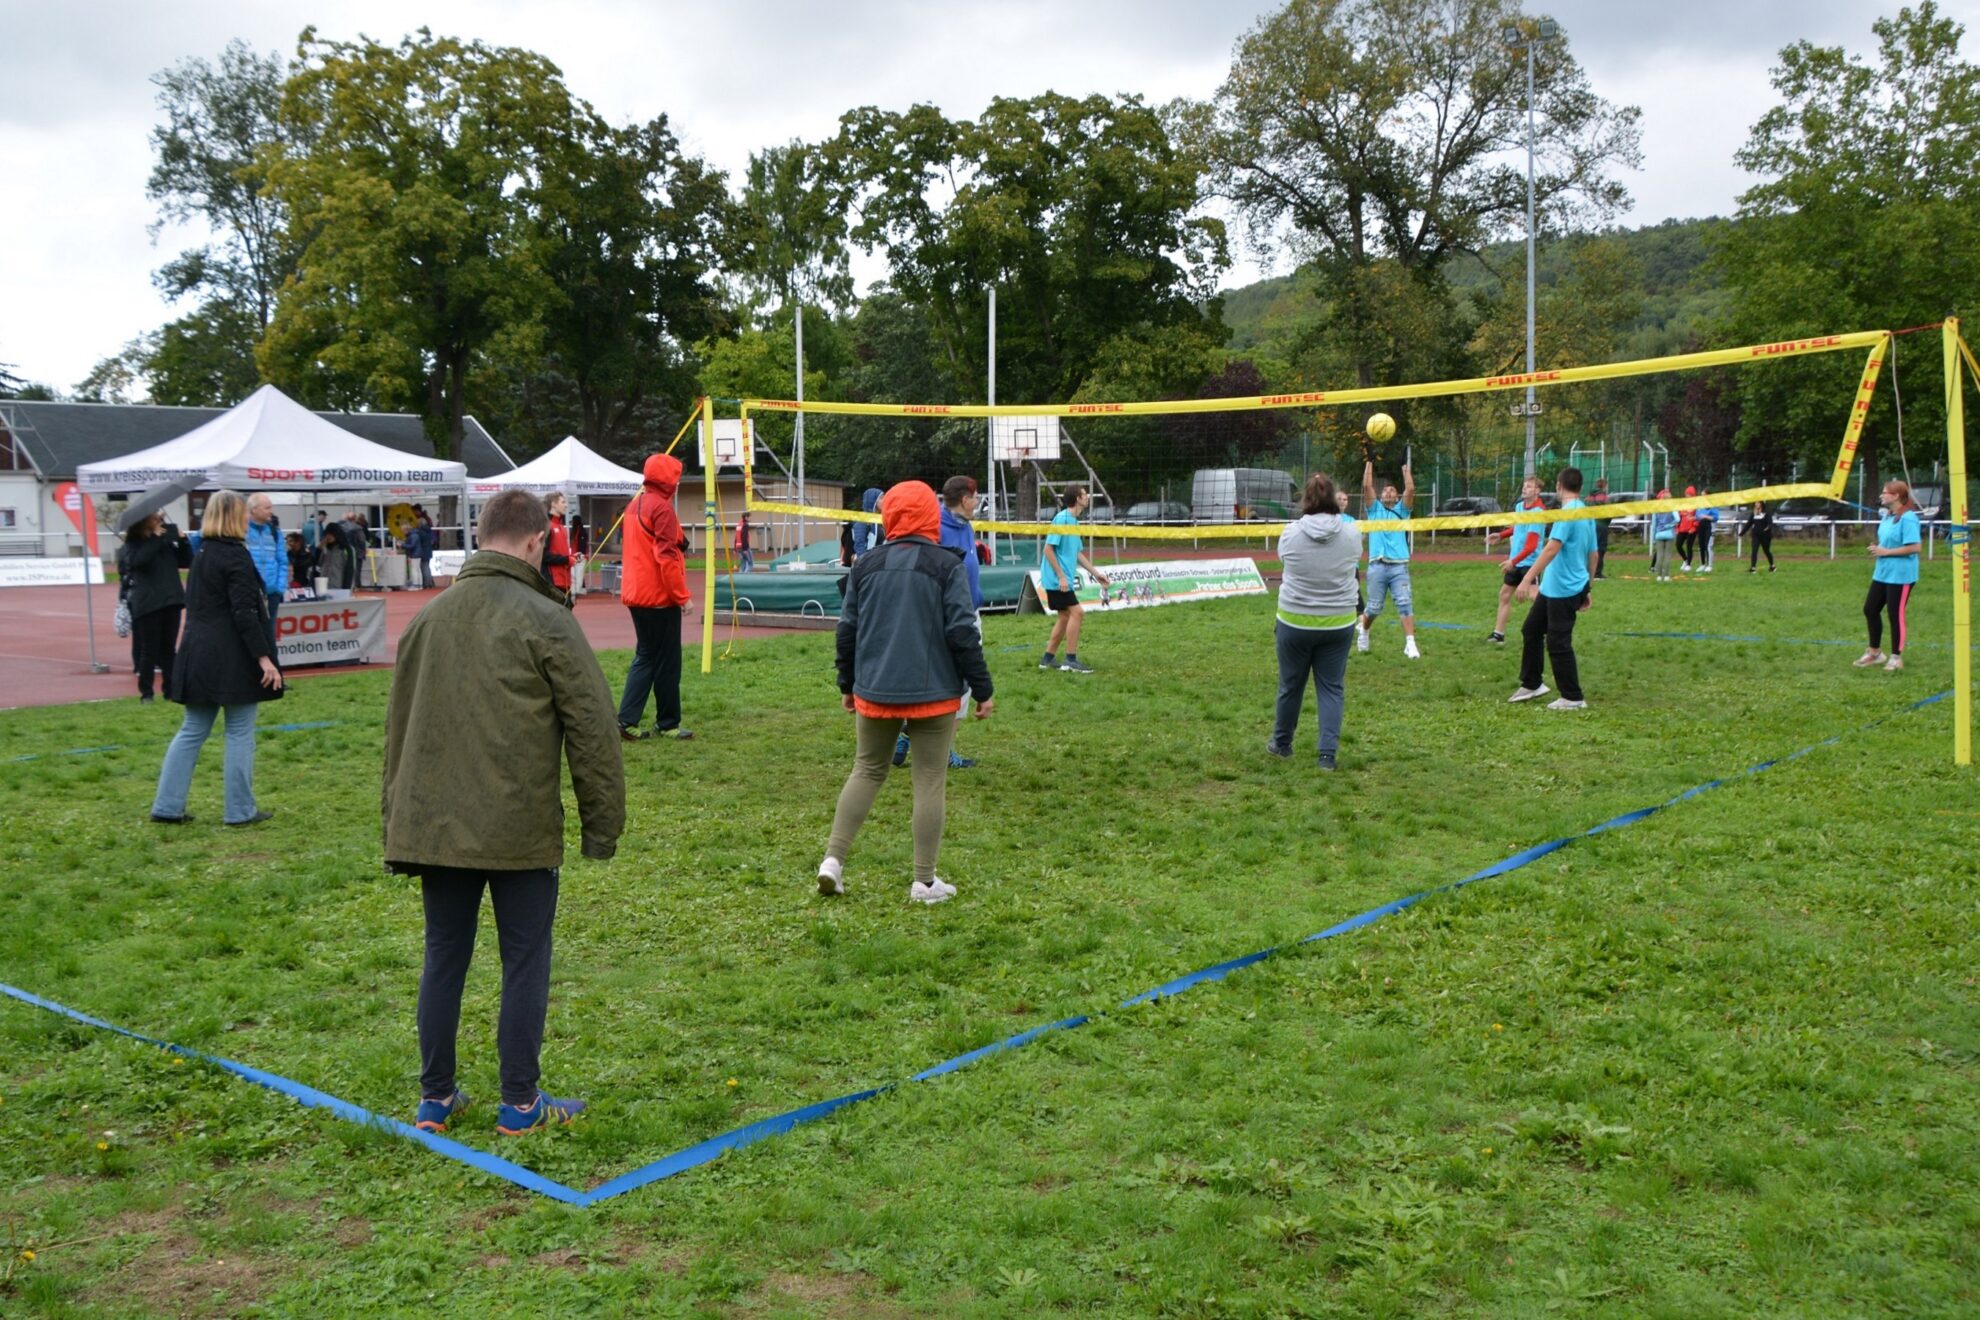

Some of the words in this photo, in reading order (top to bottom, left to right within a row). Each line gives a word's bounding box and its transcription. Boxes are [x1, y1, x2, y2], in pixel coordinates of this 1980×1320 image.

[1751, 335, 1841, 356] FUNTEC
[1486, 370, 1560, 386] FUNTEC
[1261, 392, 1325, 405] FUNTEC
[903, 405, 951, 413] FUNTEC
[1069, 404, 1124, 413] FUNTEC
[247, 467, 315, 483] sport
[321, 467, 402, 484] promotion
[407, 469, 443, 482] team
[275, 608, 359, 641] port
[326, 639, 361, 651] team
